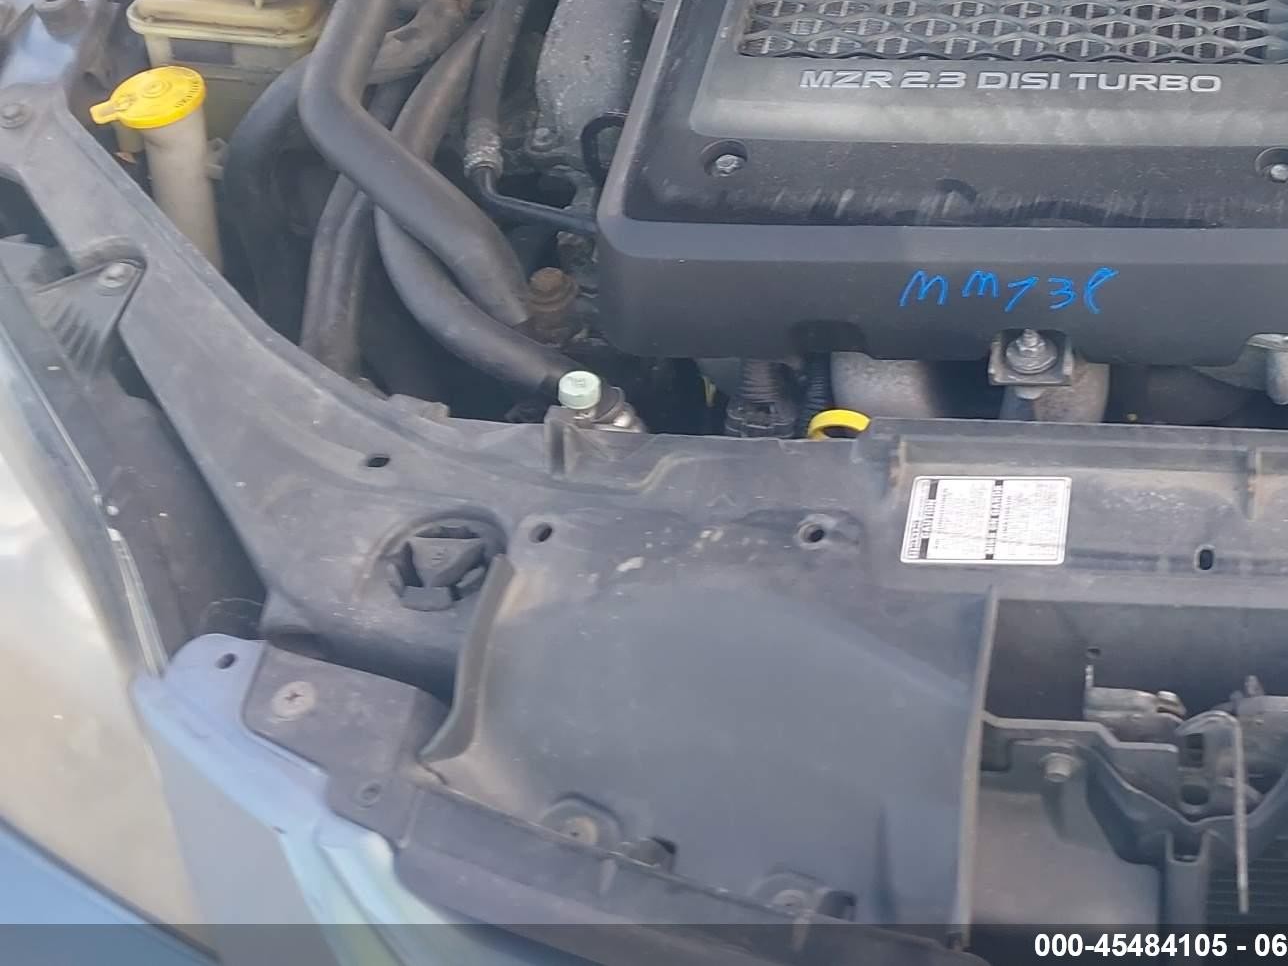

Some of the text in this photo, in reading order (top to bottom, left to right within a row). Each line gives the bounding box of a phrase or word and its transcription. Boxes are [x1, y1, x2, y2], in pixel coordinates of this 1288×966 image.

[799, 70, 1222, 93] MZR 2.3 DISI TURBO
